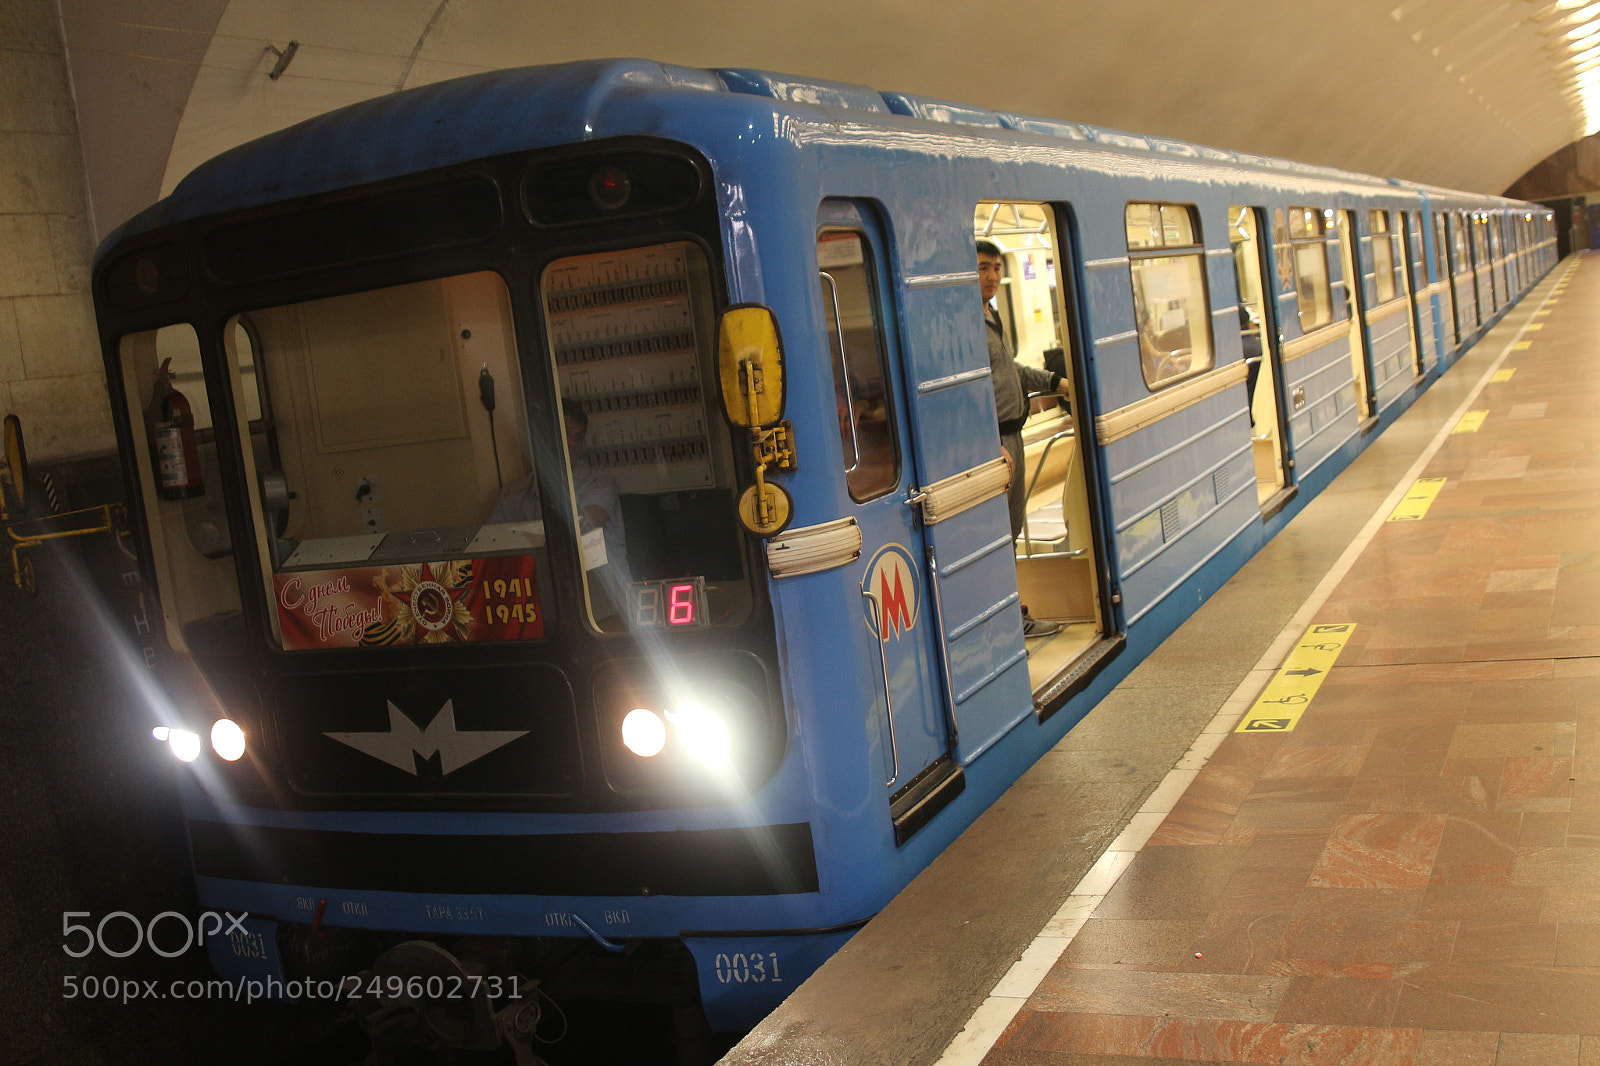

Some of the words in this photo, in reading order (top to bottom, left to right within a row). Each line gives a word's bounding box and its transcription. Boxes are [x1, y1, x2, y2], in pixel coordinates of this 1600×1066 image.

[280, 577, 304, 610] С
[483, 577, 533, 600] 1941
[670, 584, 693, 624] 6
[311, 596, 384, 641] Победы!
[485, 603, 538, 625] 1945
[715, 952, 783, 984] 0031
